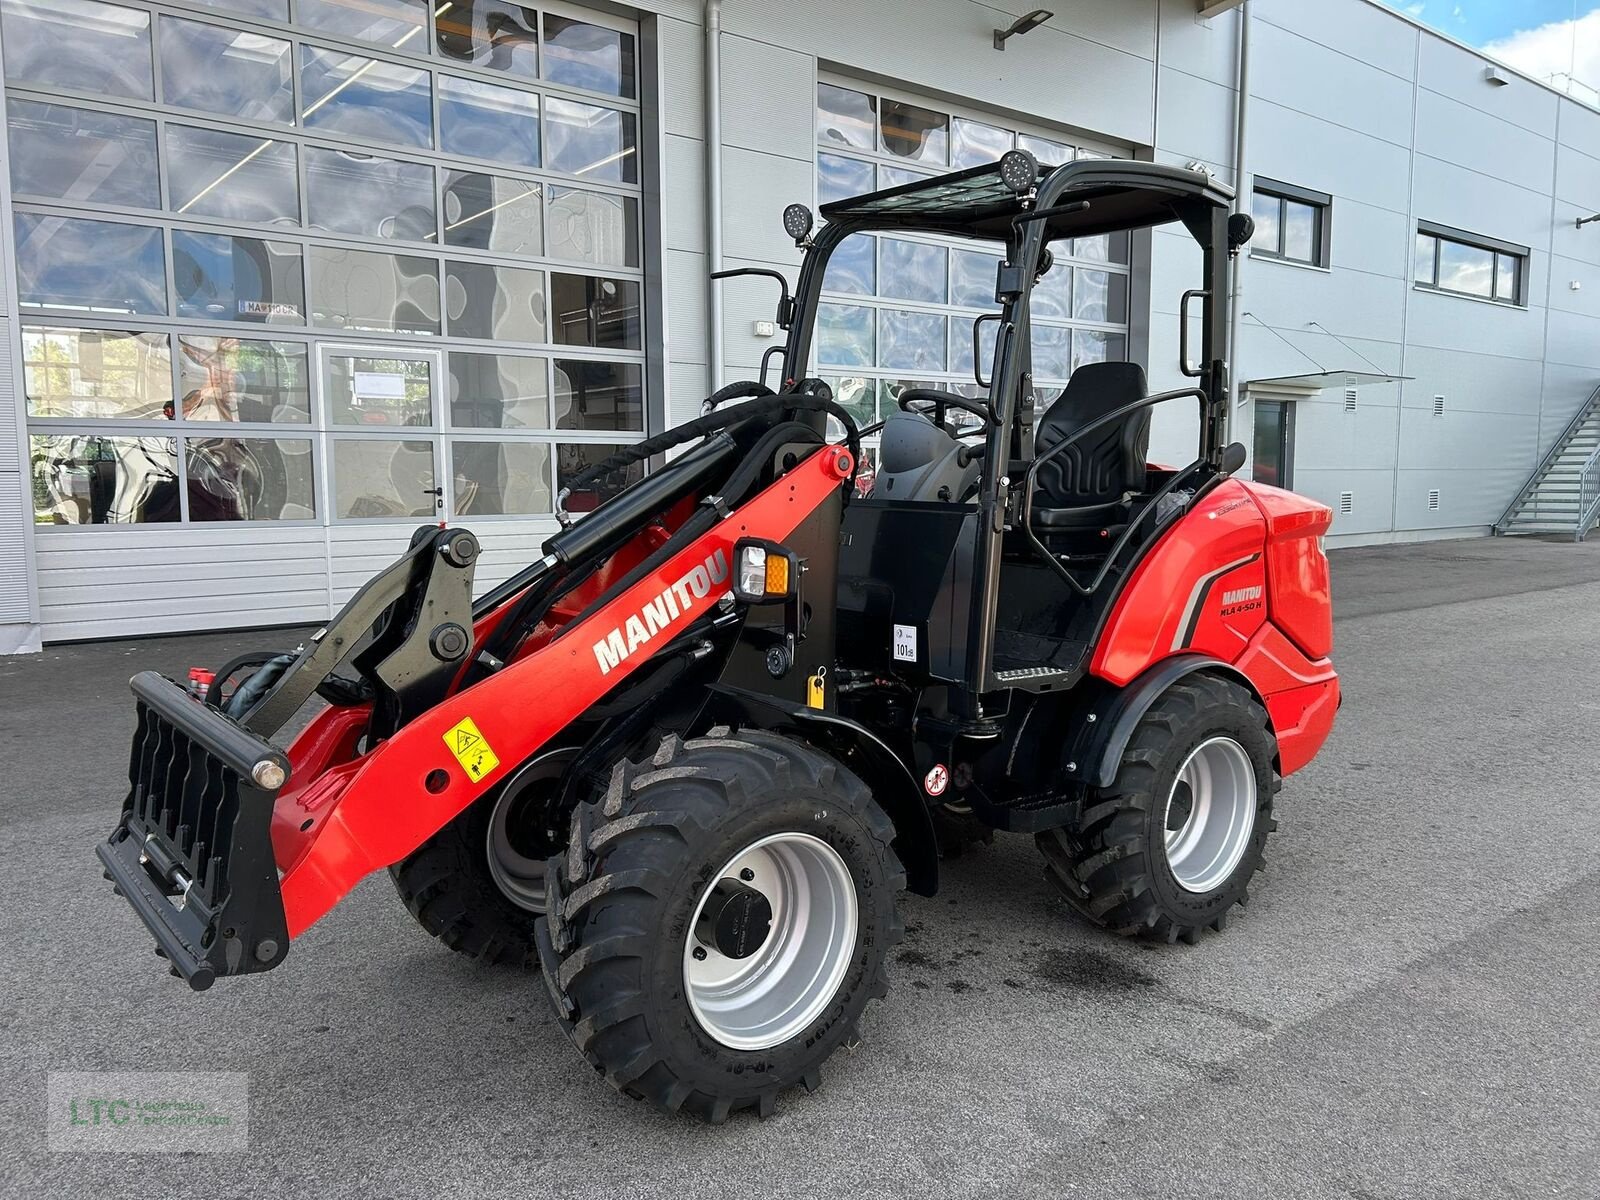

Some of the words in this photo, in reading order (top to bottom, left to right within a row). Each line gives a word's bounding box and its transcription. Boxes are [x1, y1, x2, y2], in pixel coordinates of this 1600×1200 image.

[248, 302, 261, 312] MA
[1222, 585, 1262, 606] MANITOU
[592, 548, 729, 676] MANITOU
[1255, 601, 1262, 610] H
[896, 643, 908, 656] 101
